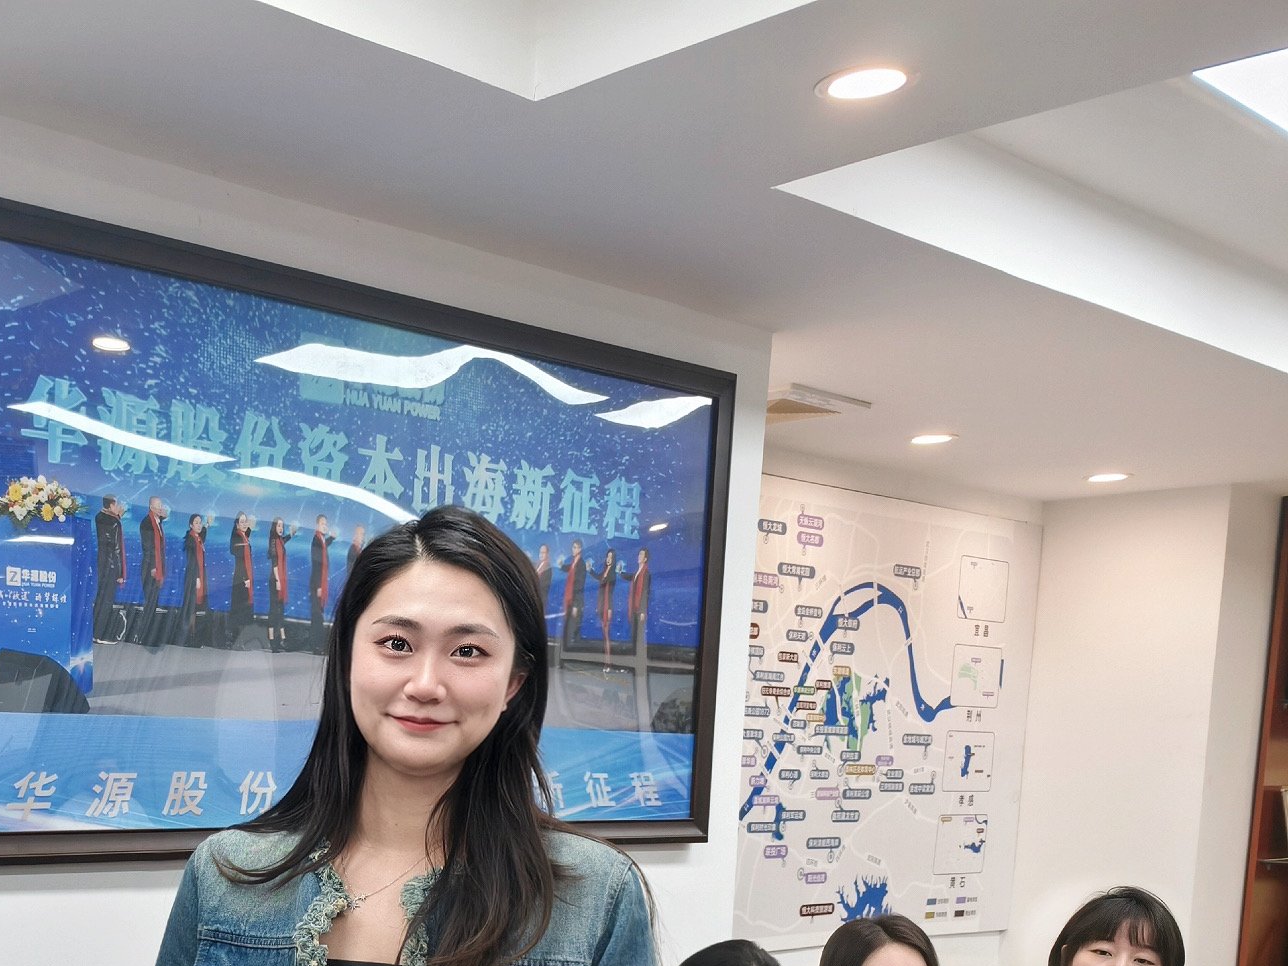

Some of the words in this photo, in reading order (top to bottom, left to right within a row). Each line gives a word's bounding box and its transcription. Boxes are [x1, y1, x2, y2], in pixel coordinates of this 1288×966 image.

[21, 374, 642, 541] 华源股份资本出海新征程
[6, 769, 277, 821] 华源股份
